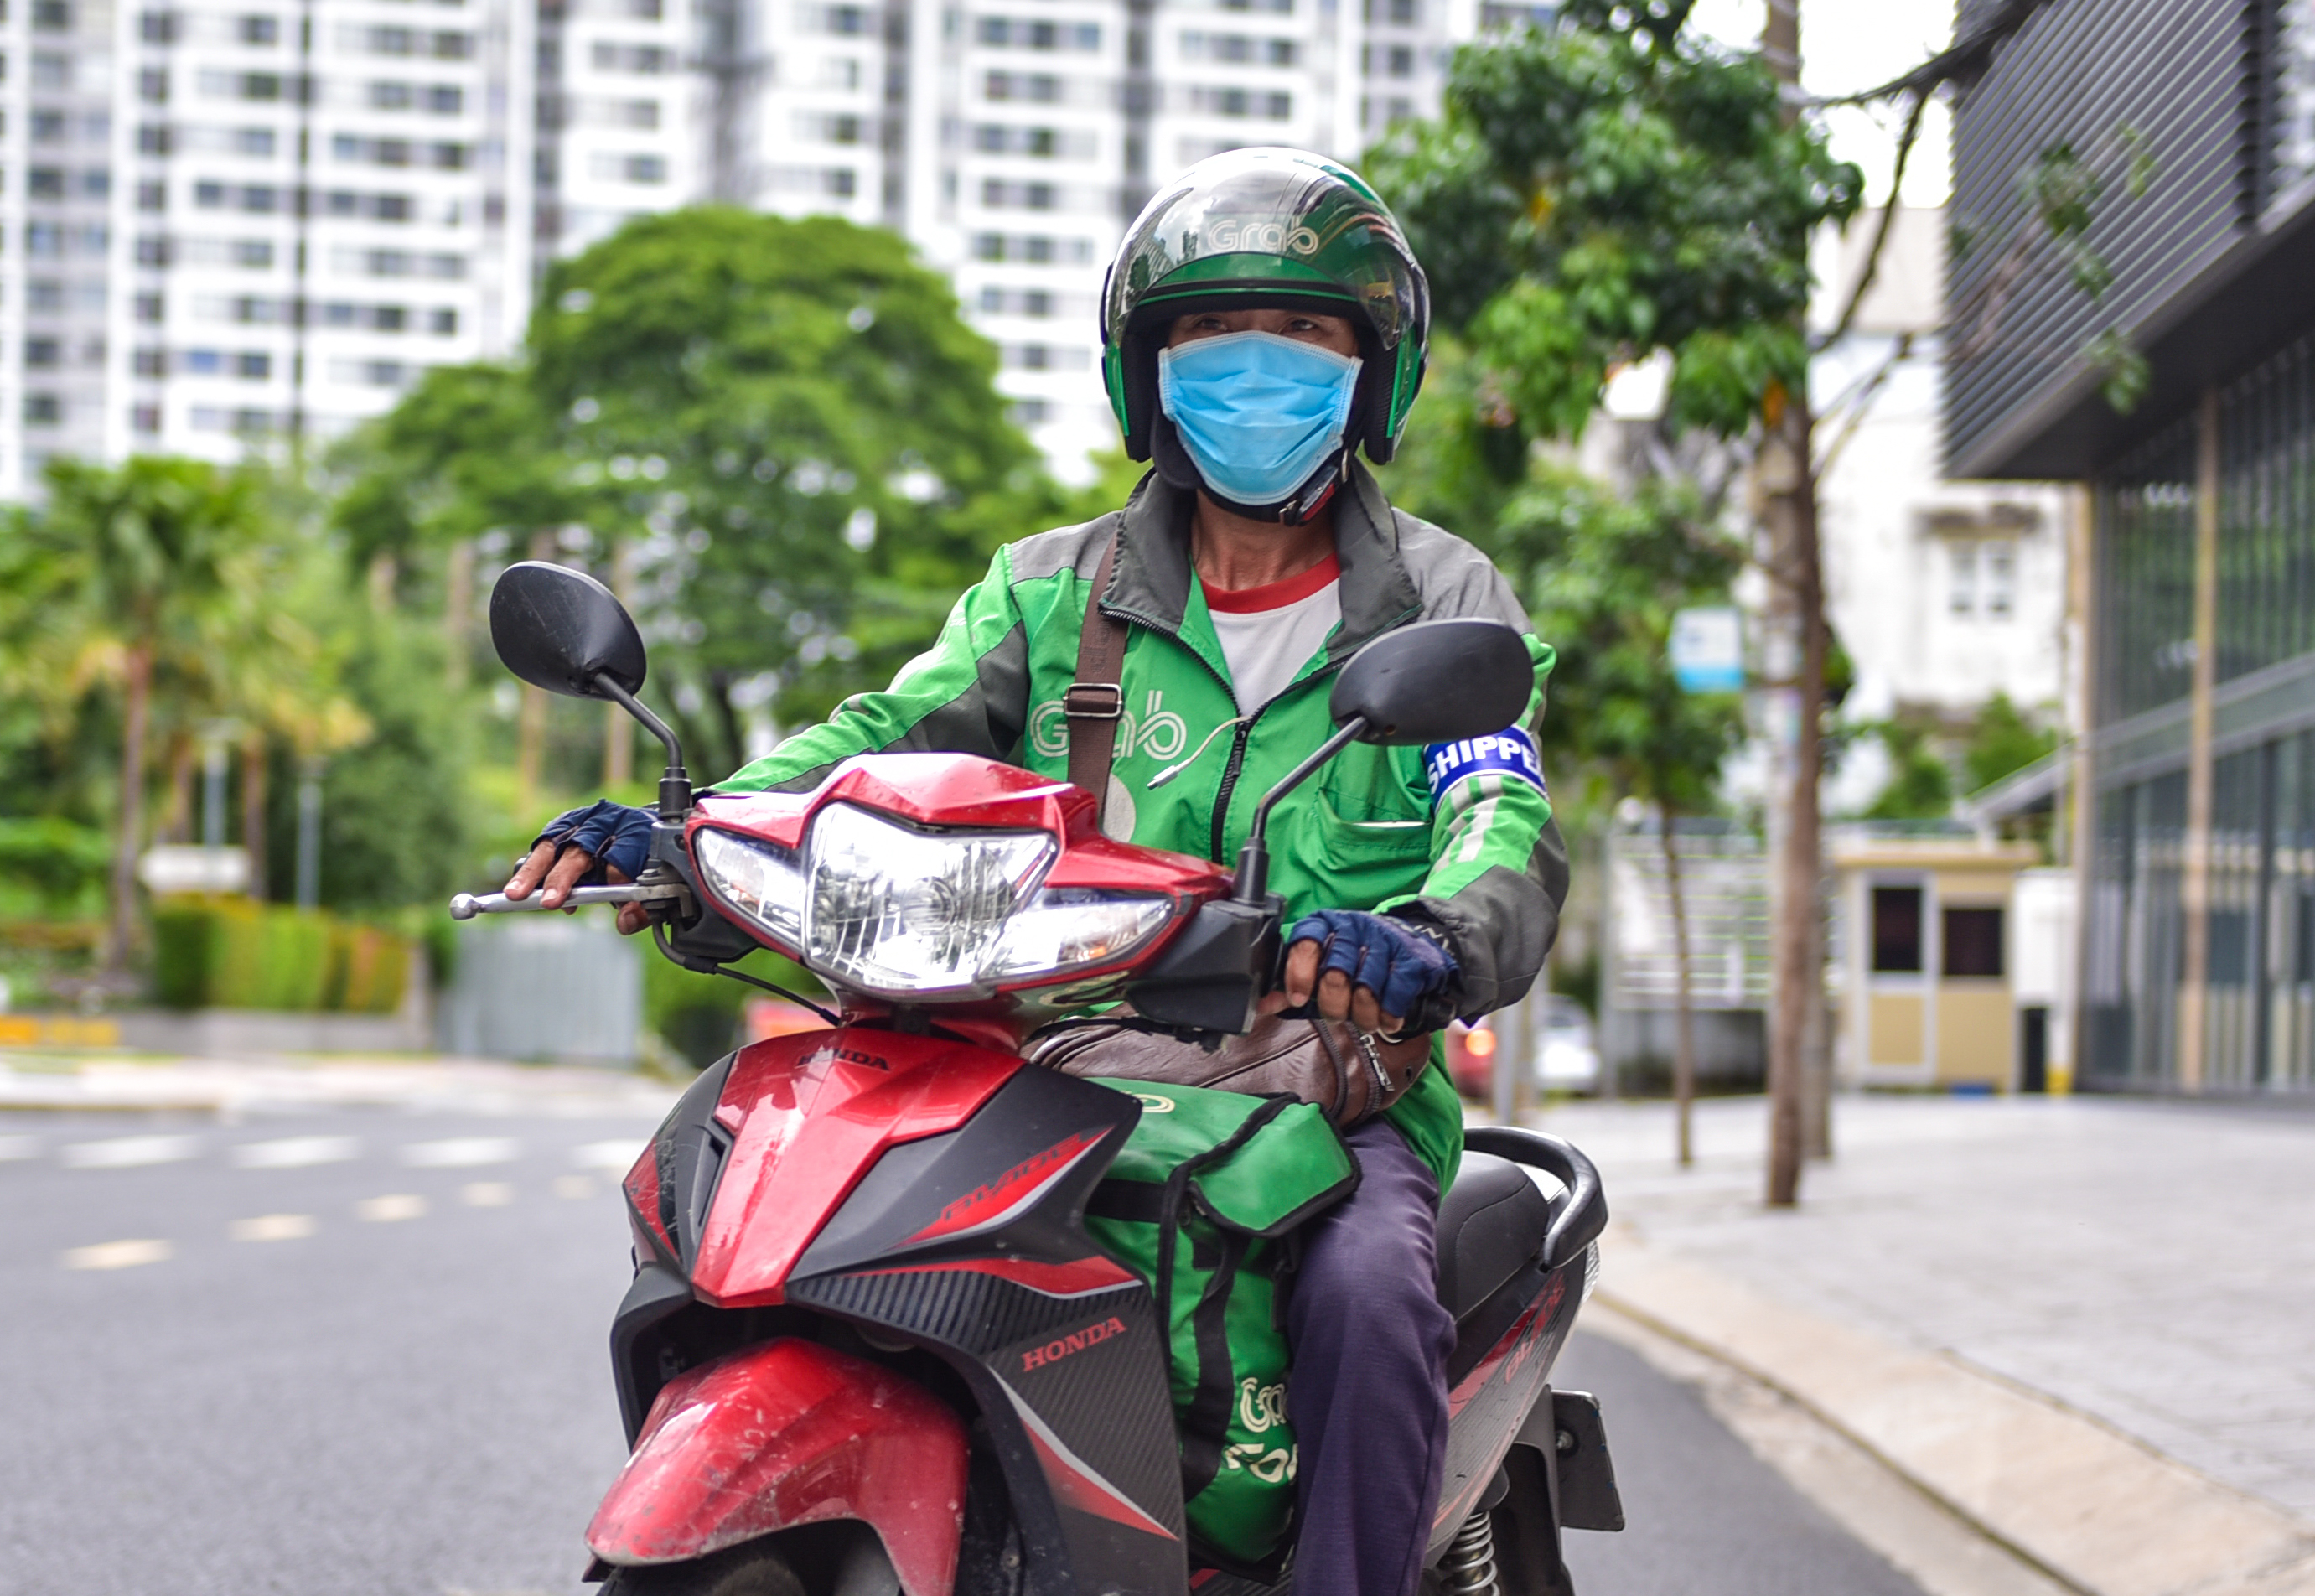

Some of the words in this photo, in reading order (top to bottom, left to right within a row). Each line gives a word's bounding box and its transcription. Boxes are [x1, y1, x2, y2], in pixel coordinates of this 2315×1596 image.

[1209, 215, 1319, 255] Grab
[1030, 690, 1187, 761] Gab
[1427, 736, 1544, 795] SHIPPE
[1022, 1316, 1127, 1373] HONDA
